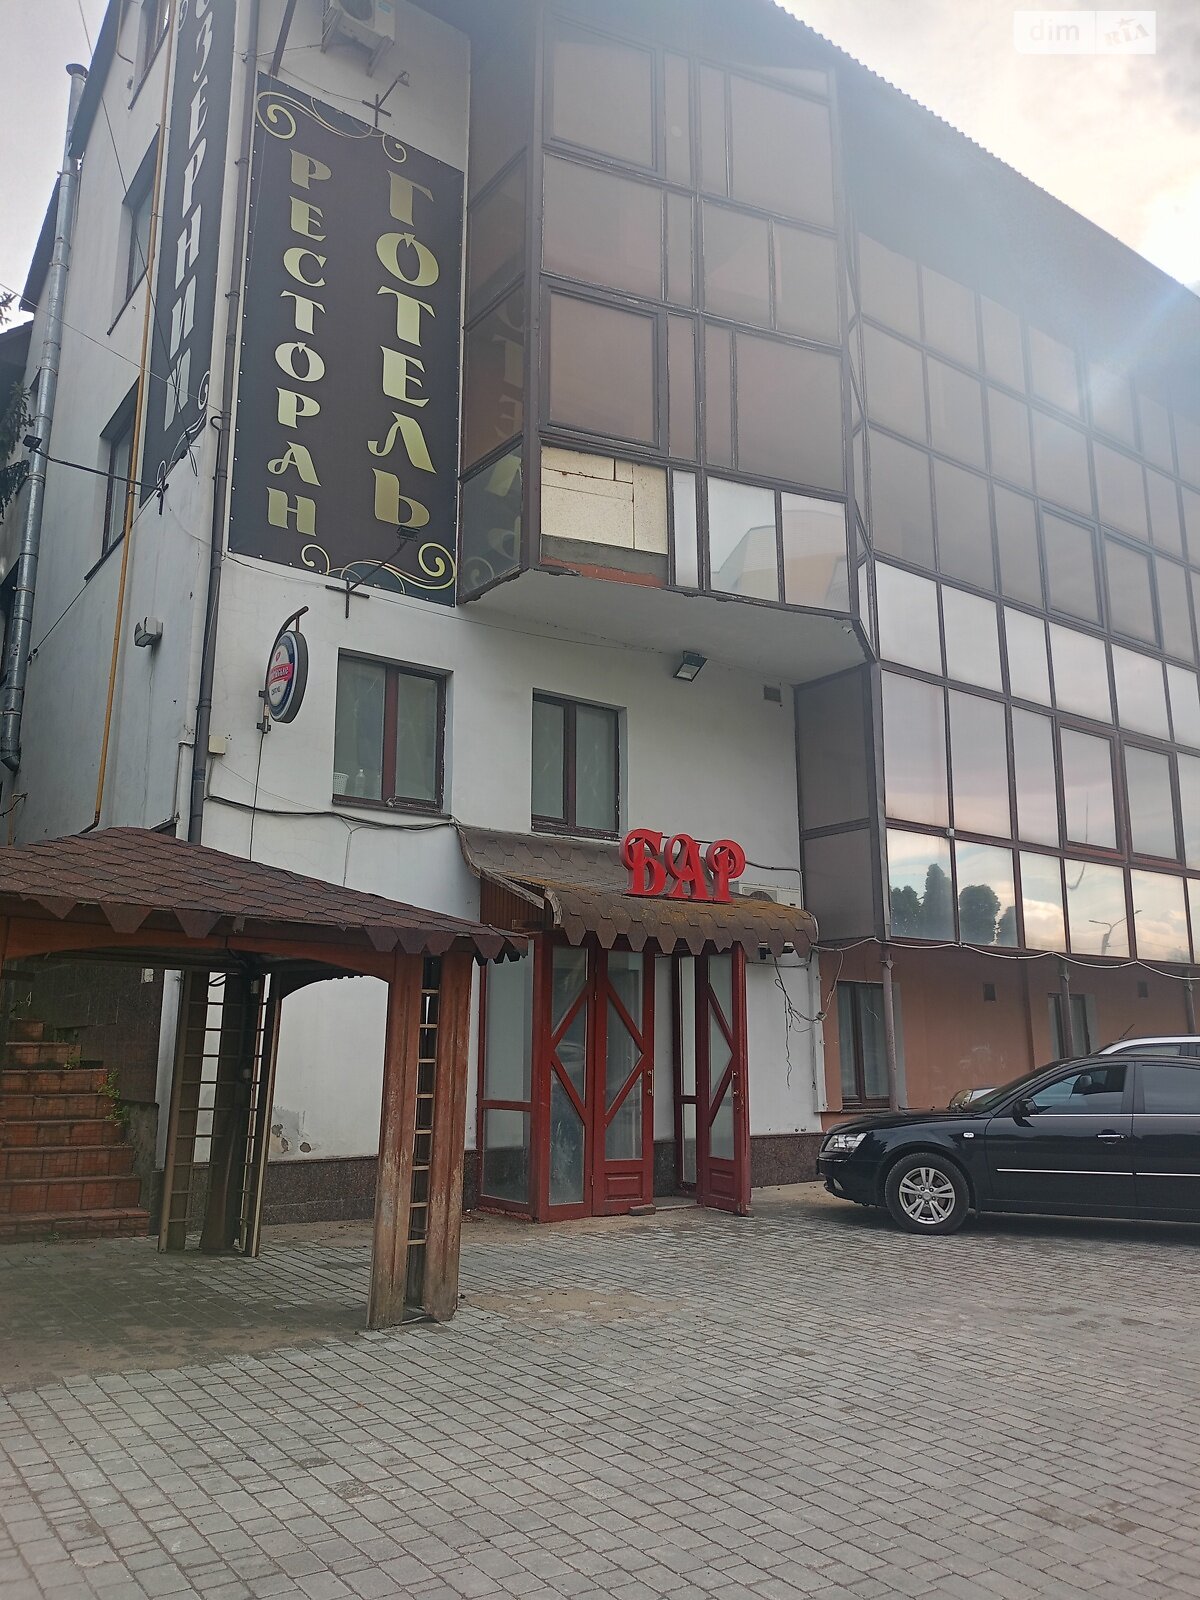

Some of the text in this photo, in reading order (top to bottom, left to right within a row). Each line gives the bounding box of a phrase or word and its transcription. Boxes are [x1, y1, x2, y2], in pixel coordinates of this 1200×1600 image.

[164, 0, 215, 432] ЗЕРНИЙ
[267, 149, 332, 537] РЕСТОРАН
[368, 170, 439, 529] ГОТЕЛЬ
[619, 828, 746, 903] БАР
